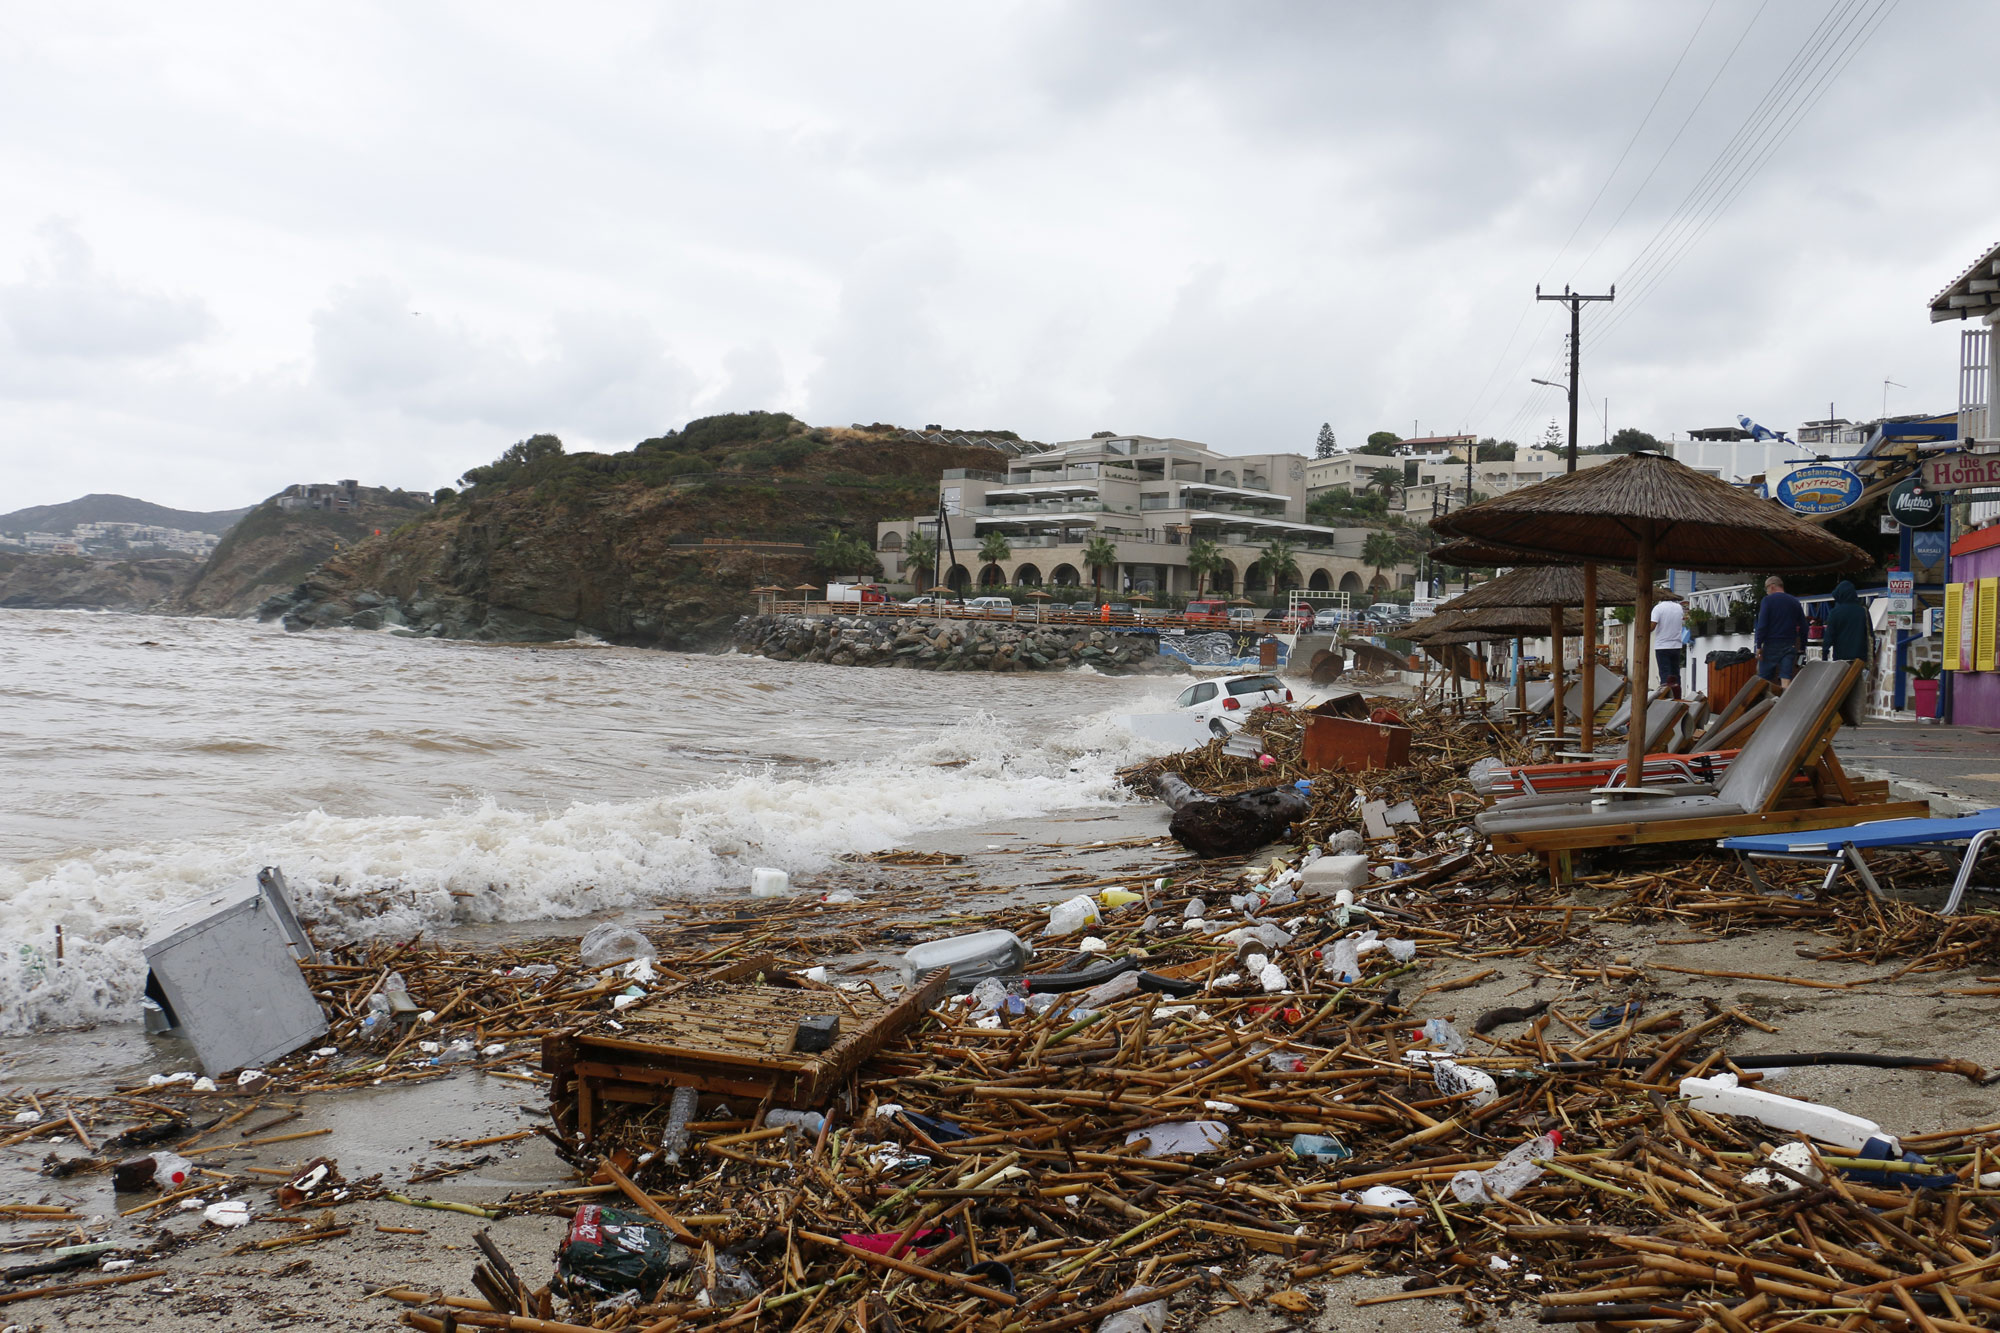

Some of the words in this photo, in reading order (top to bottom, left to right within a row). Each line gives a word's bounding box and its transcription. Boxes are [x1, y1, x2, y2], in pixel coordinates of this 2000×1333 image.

[1960, 455, 1980, 468] the
[1796, 469, 1842, 478] Restaurant
[1795, 479, 1847, 490] MYTHOS
[1794, 501, 1816, 512] Greek
[1818, 501, 1847, 512] taverna
[1895, 493, 1933, 512] Mythos
